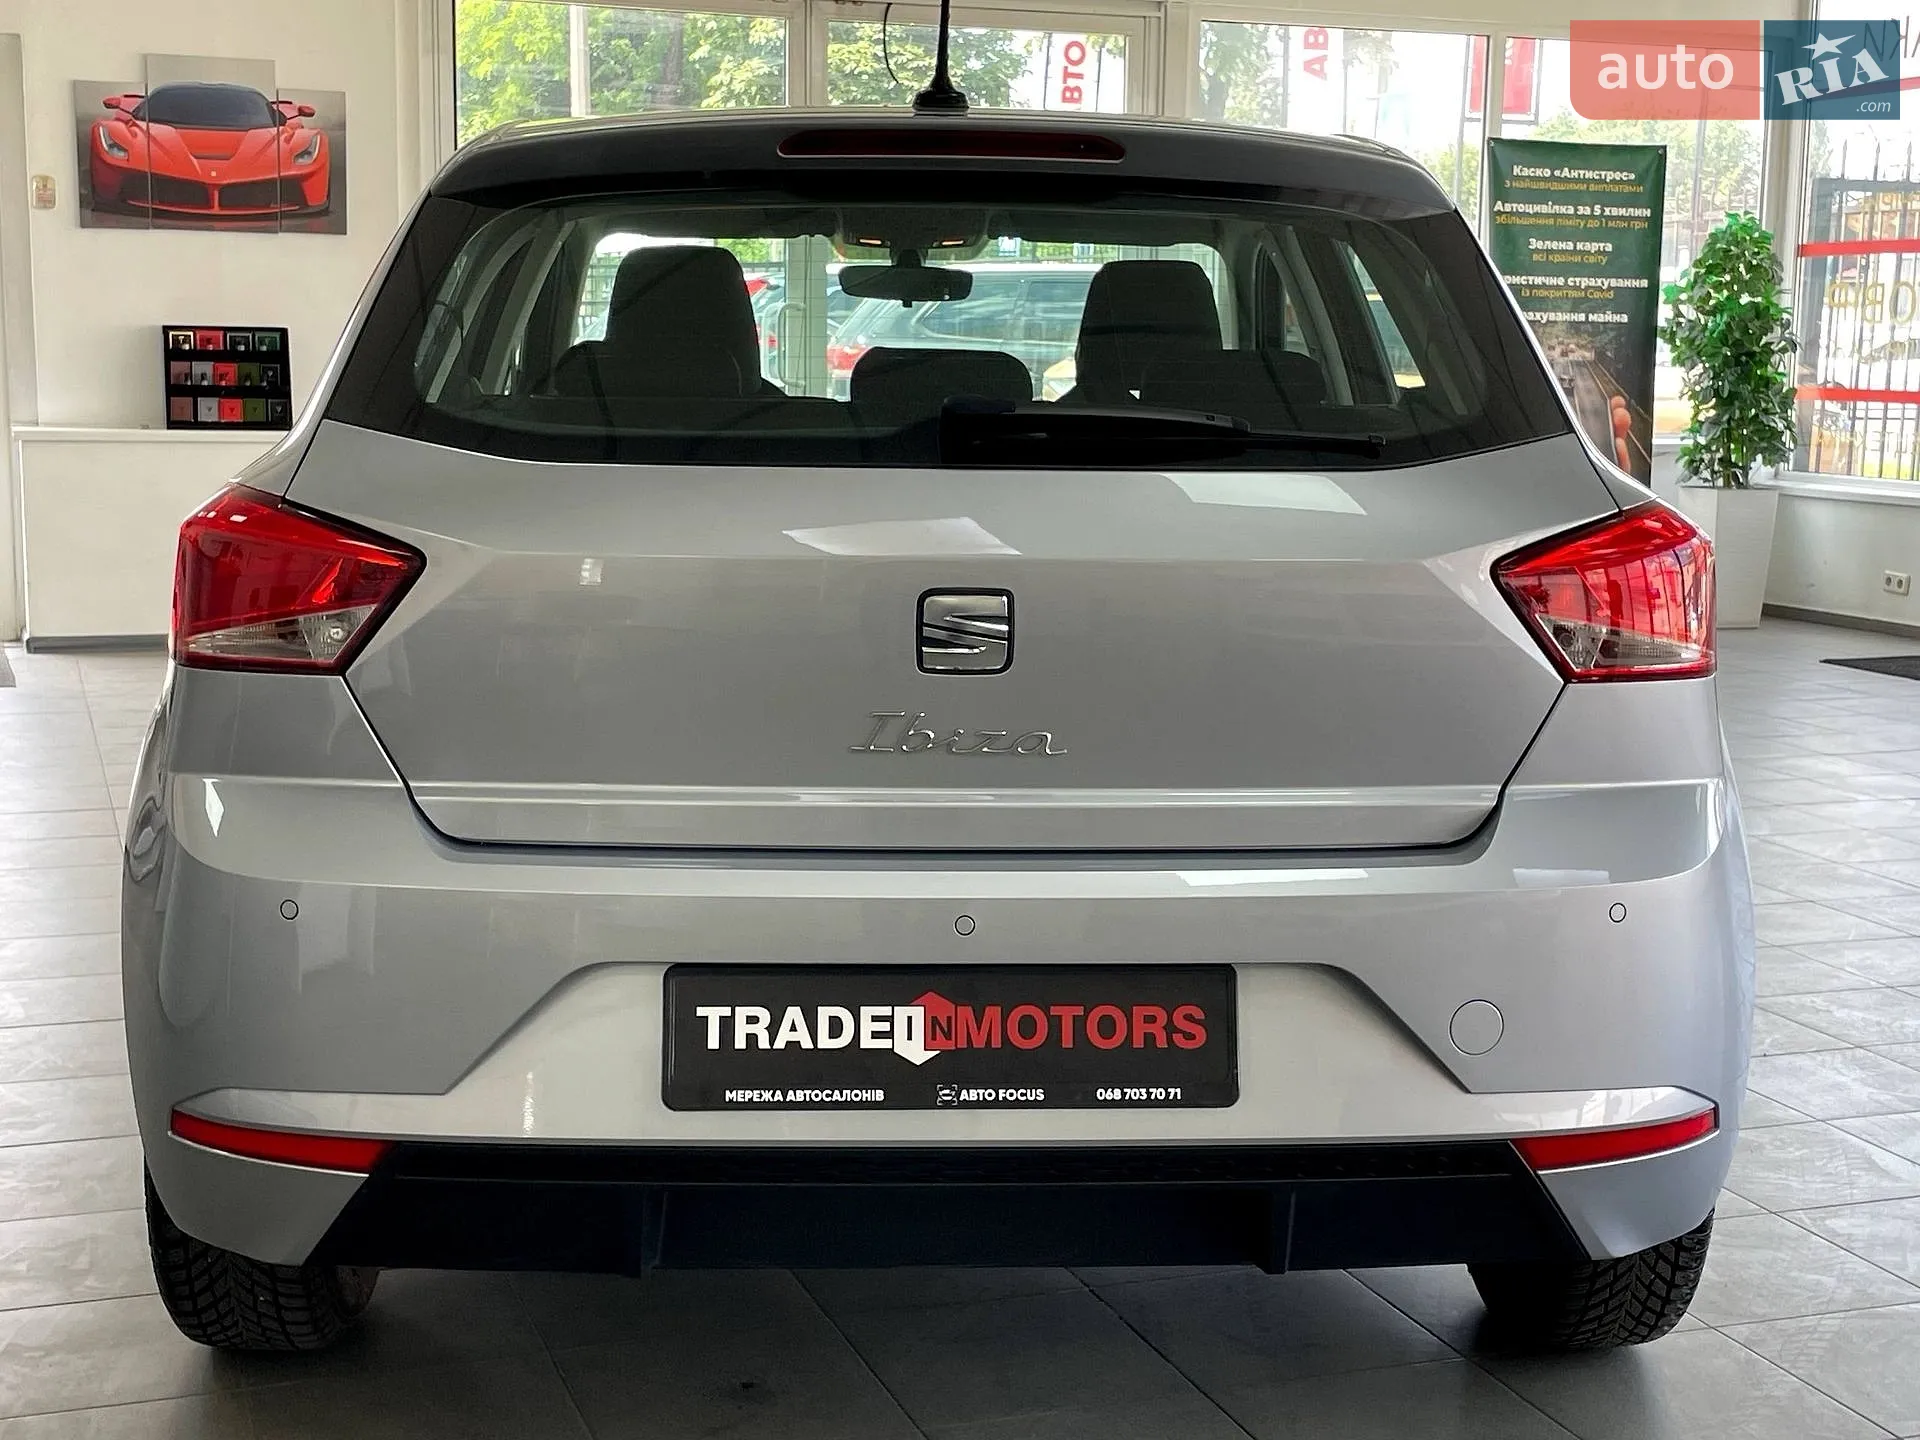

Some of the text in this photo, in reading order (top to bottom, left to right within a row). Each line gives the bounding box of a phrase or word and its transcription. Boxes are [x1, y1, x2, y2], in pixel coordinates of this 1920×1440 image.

[1512, 165, 1636, 182] Каско «Антистрес»
[1493, 200, 1651, 217] Автоцивілка за 5 хвилин
[1586, 219, 1600, 229] до
[1528, 238, 1613, 253] Зелена карта
[1567, 277, 1648, 289] страхування
[1586, 290, 1614, 299] Covid
[1588, 311, 1629, 324] майна
[850, 710, 1068, 756] Ibiza
[725, 1089, 885, 1102] МЕРЕЖА АВТОСАЛОНІВ
[959, 1088, 1044, 1101] АВТО FOCUS
[1096, 1088, 1182, 1100] 068 703 70 71
